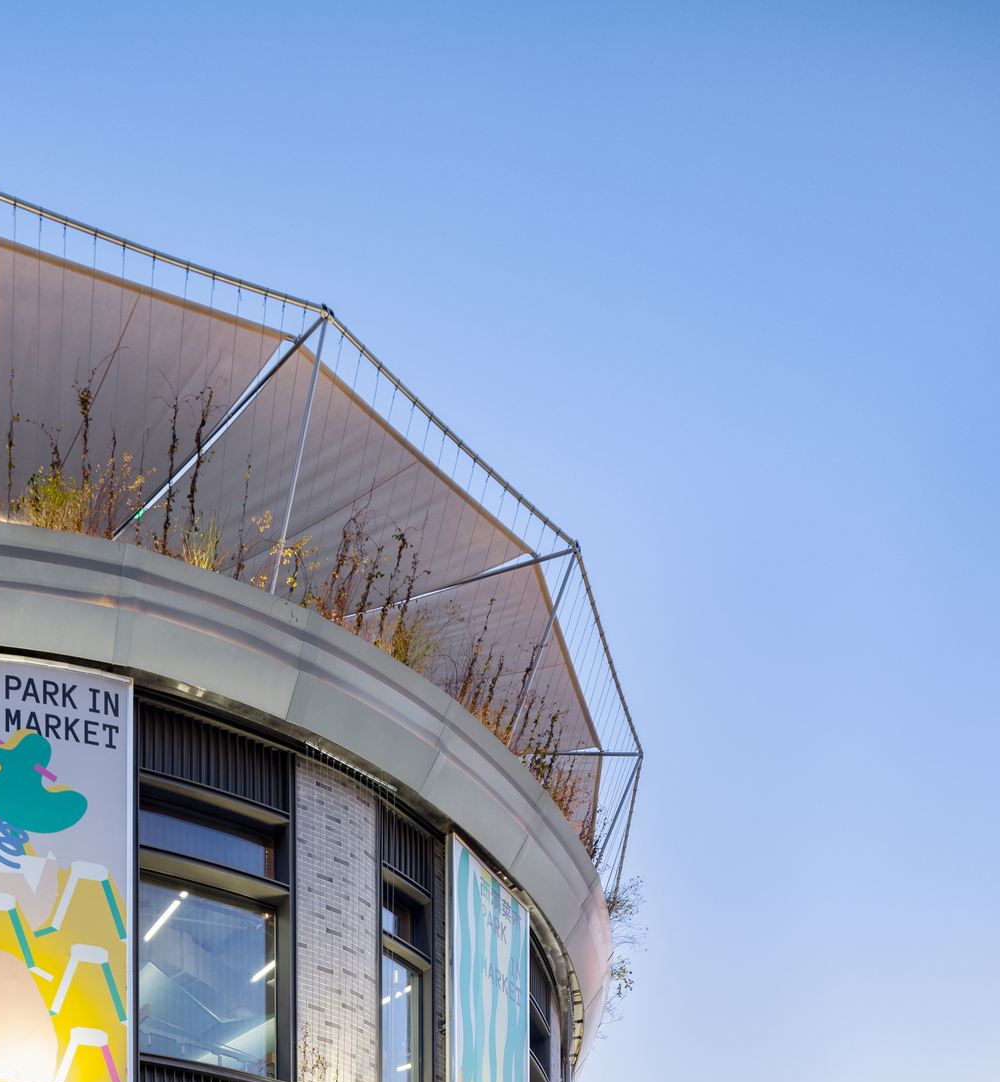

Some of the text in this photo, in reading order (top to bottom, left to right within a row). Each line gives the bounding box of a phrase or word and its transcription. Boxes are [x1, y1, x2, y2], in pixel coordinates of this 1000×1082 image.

[4, 674, 78, 710] PARK
[89, 687, 120, 718] IN
[5, 708, 120, 750] MARKET
